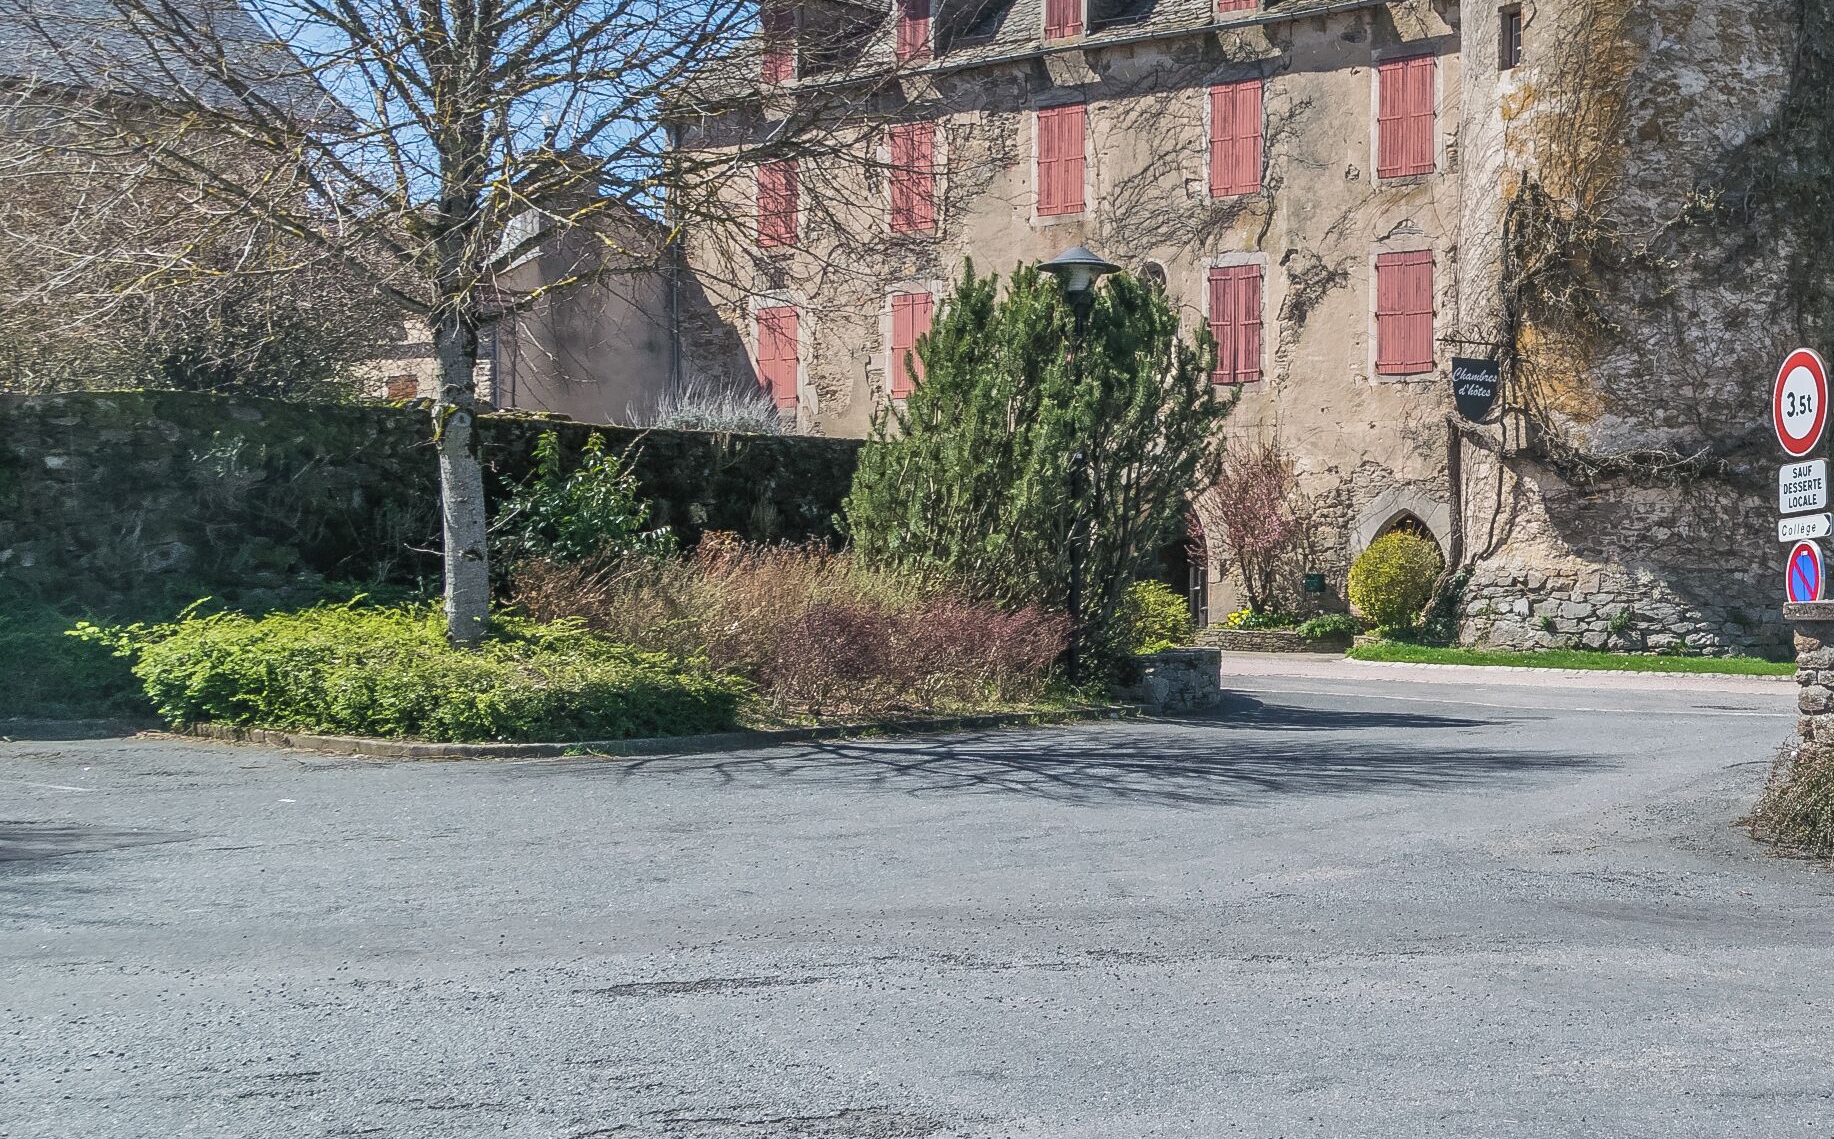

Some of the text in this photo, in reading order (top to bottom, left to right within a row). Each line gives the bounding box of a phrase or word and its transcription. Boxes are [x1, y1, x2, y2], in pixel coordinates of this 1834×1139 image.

[1452, 367, 1498, 382] Chambres
[1458, 383, 1491, 397] d'hôtes
[1792, 465, 1812, 479] SAUF
[1783, 478, 1822, 495] DESSERTE
[1788, 494, 1817, 509] LOCALE
[1781, 523, 1816, 537] Collège
